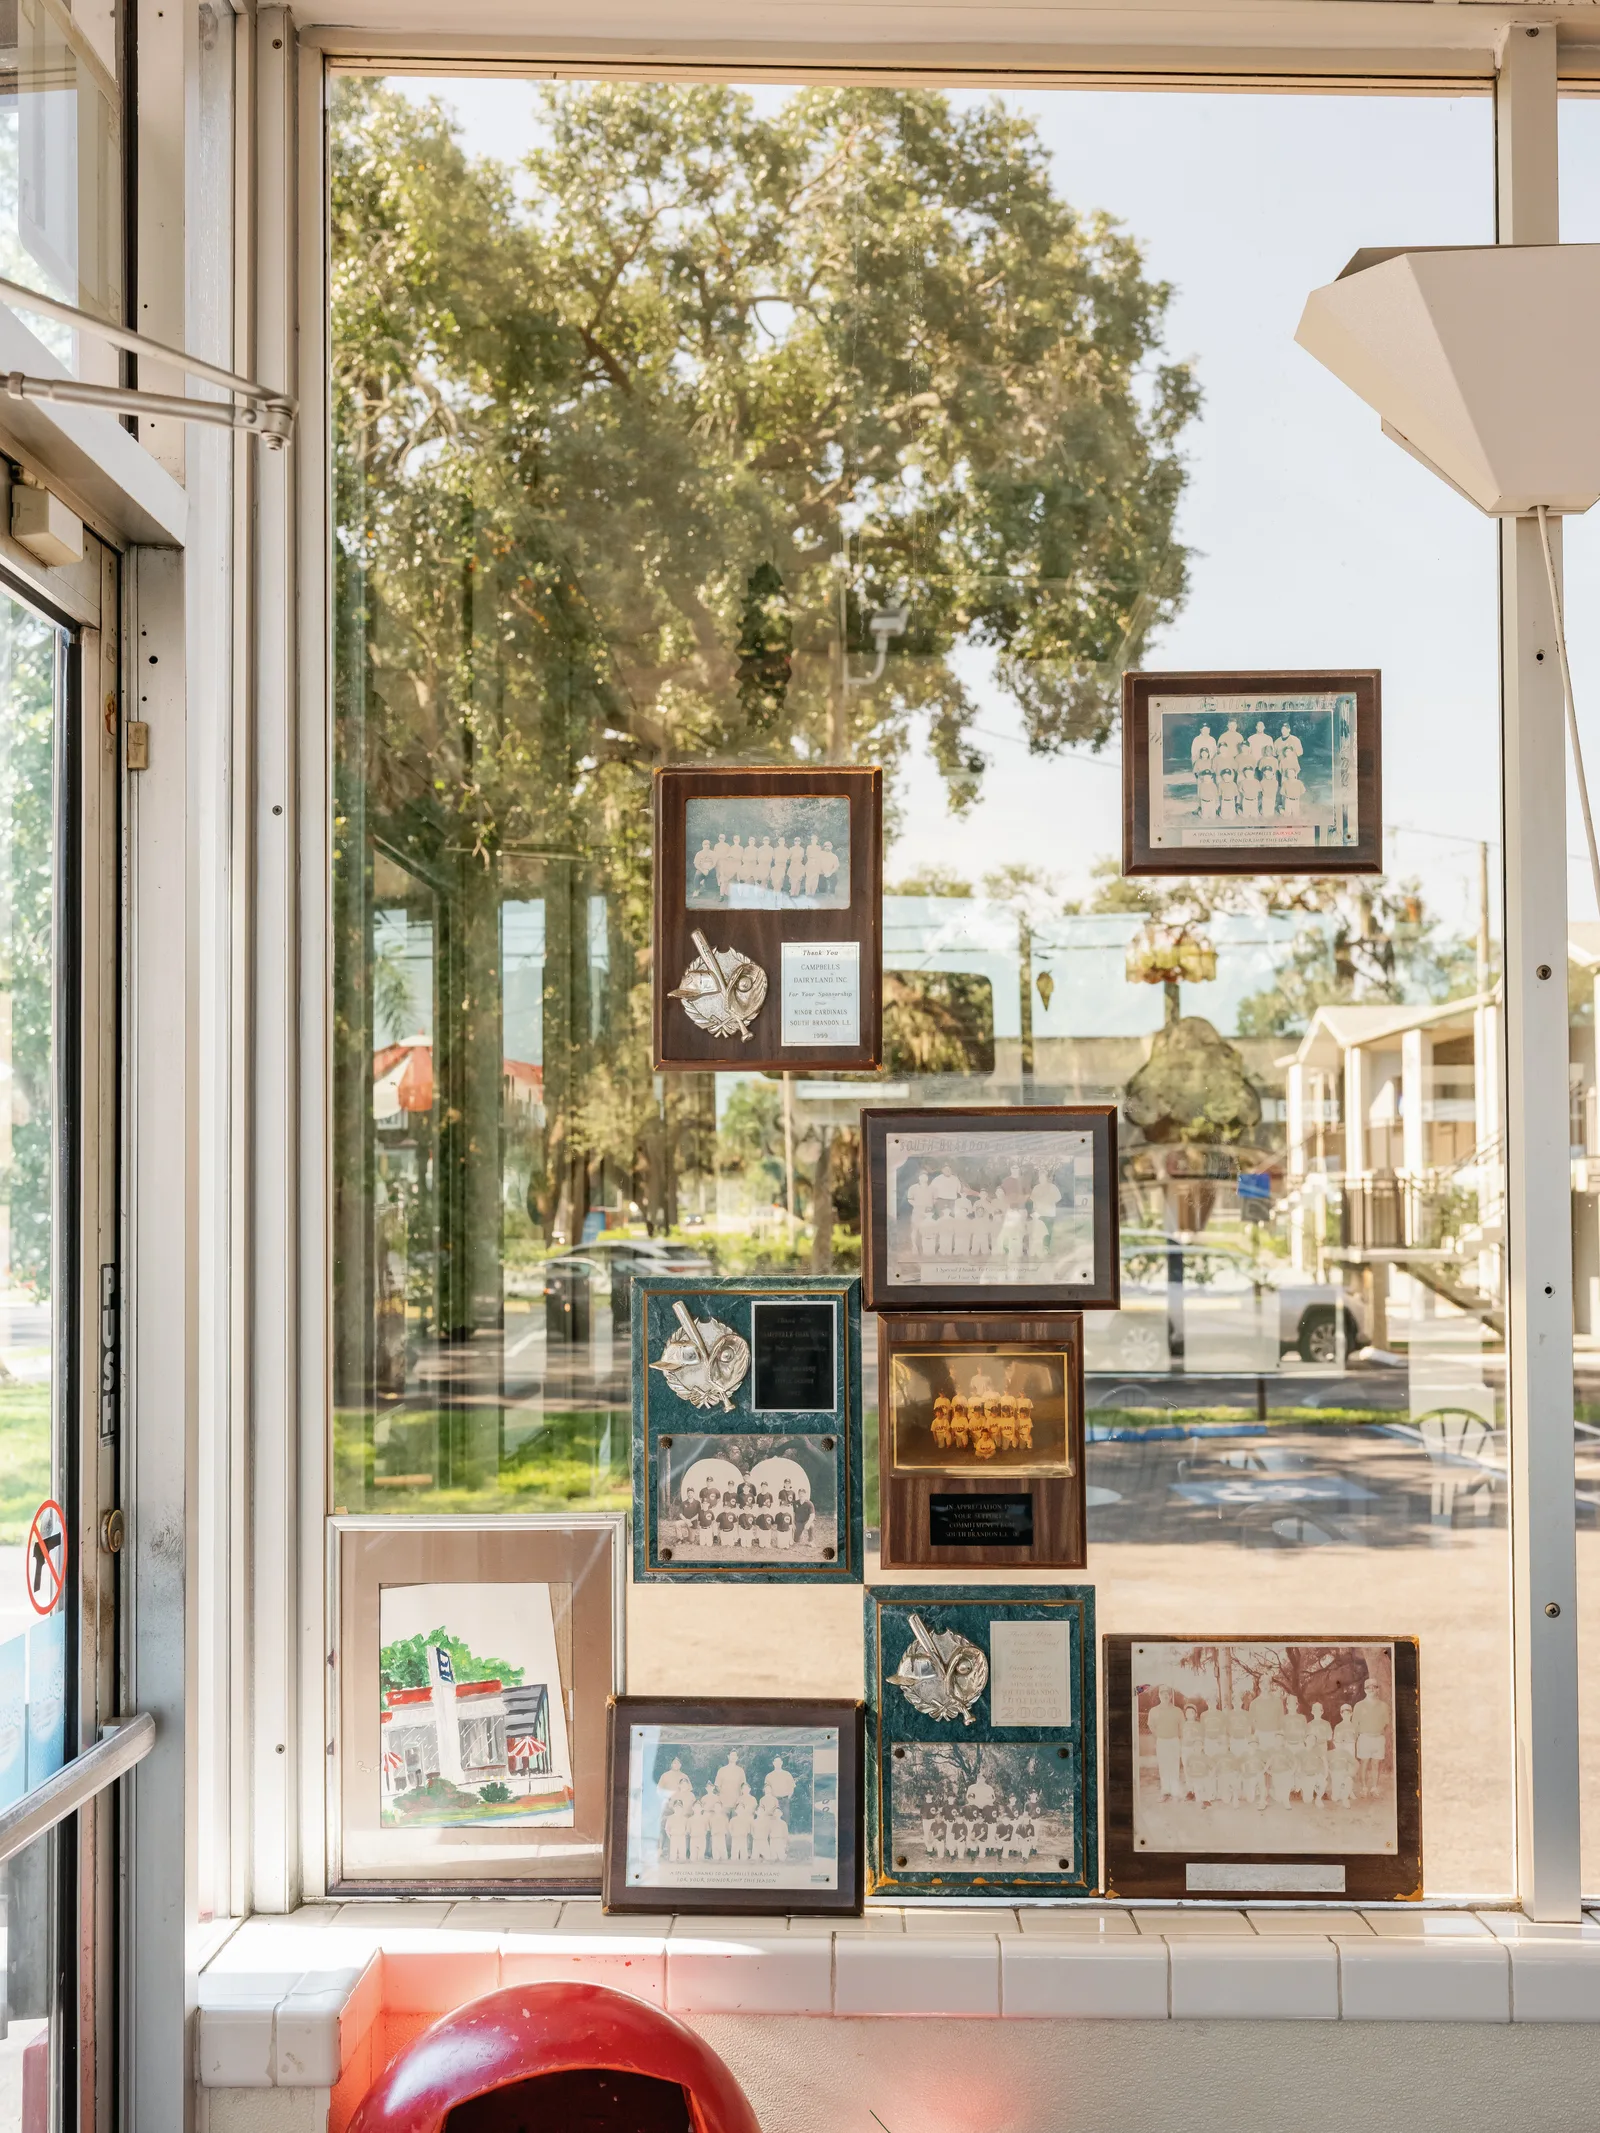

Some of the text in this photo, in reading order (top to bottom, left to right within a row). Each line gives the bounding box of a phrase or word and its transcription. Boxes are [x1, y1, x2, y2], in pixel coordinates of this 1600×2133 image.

[793, 976, 833, 984] DAIRYLAND
[899, 1139, 934, 1152] SOUTH
[939, 1138, 991, 1152] BRANDON
[102, 1266, 115, 1435] PUSH
[1026, 1688, 1060, 1697] BRANDON
[1000, 1706, 1063, 1720] 2000
